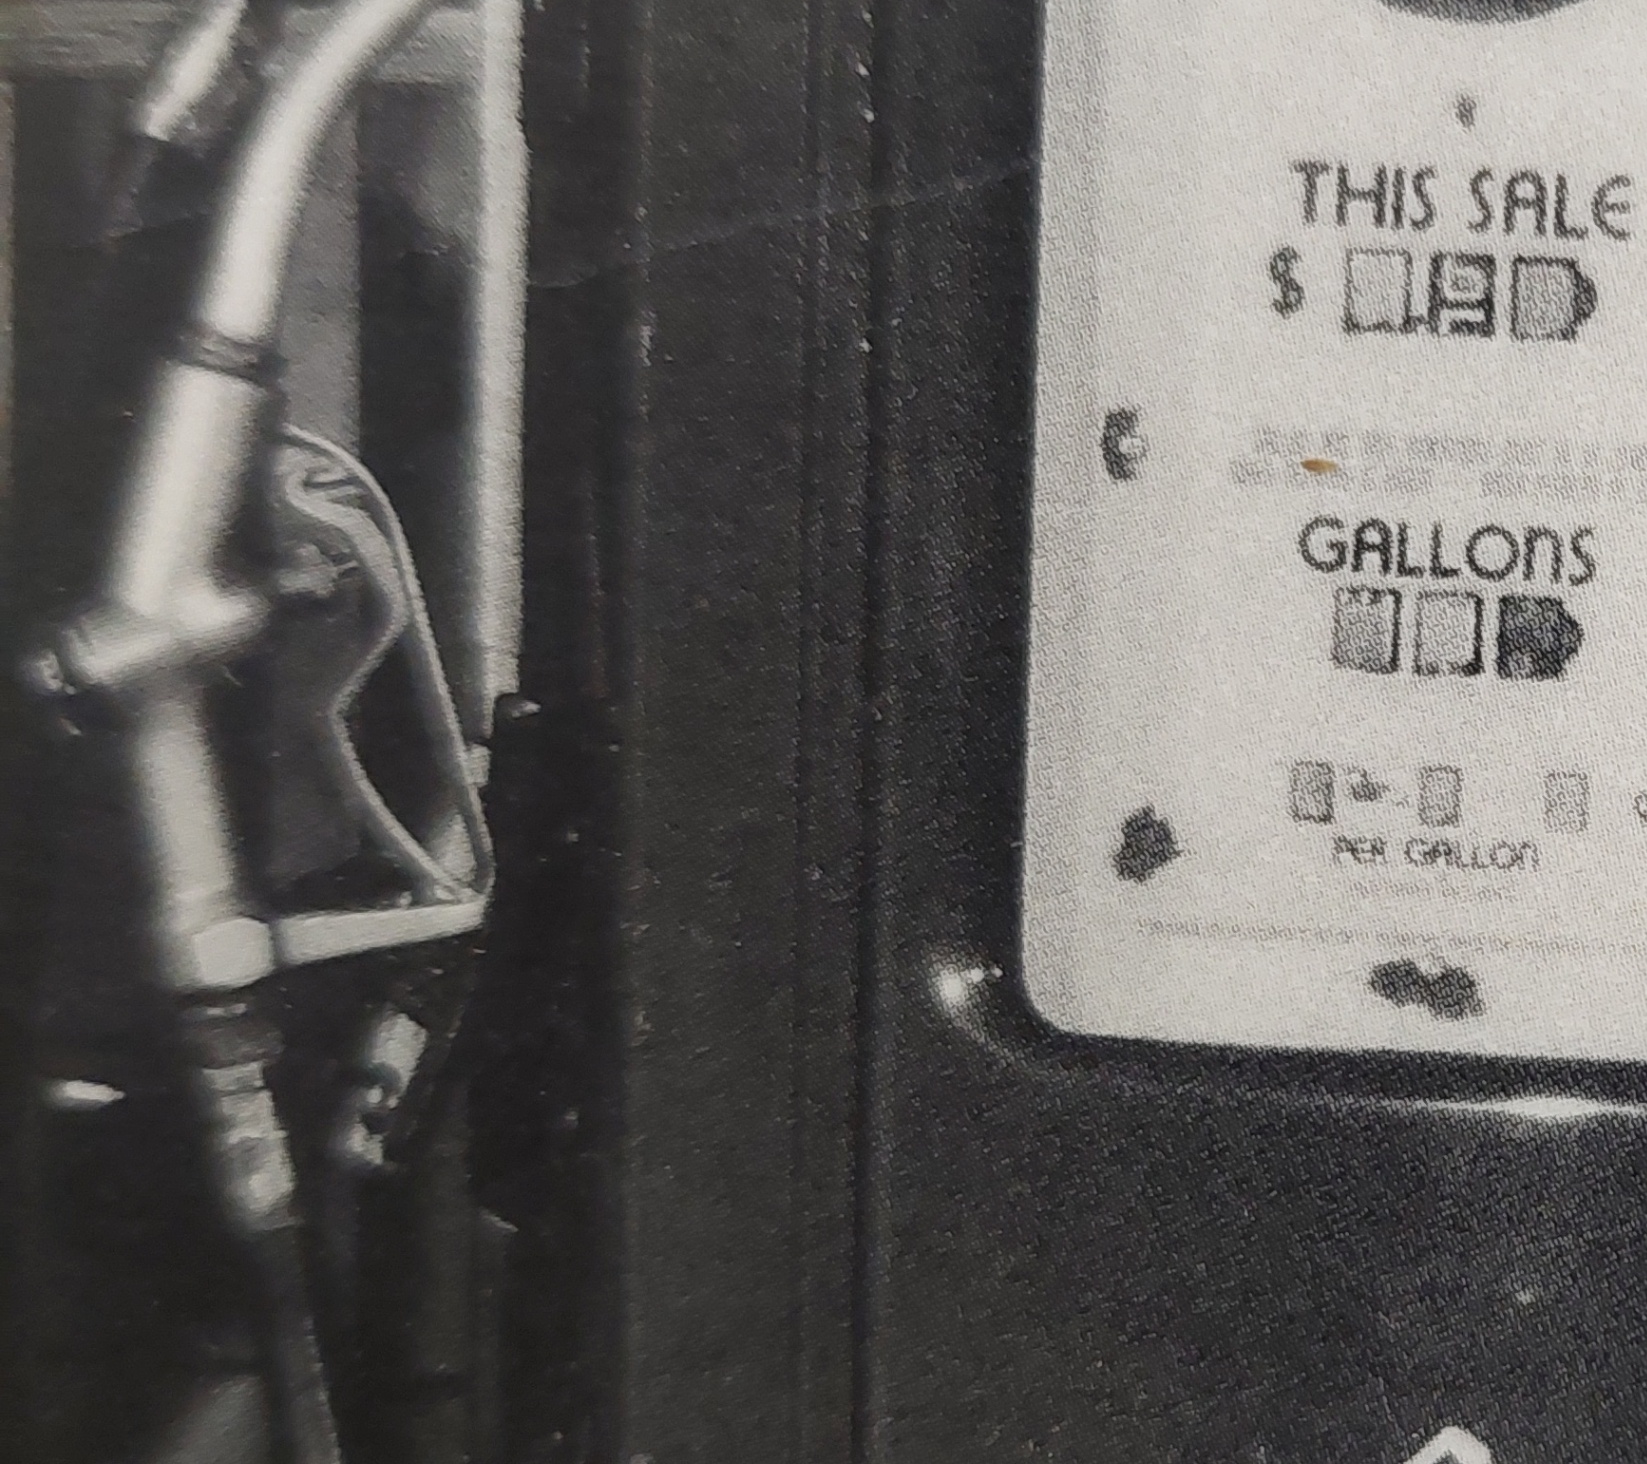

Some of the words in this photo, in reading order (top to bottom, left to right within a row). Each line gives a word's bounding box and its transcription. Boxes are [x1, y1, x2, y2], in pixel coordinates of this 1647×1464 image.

[1288, 158, 1436, 232] THIS
[1466, 168, 1635, 242] SALE
[1266, 245, 1304, 320] $
[1297, 515, 1598, 588] GALLONS
[1332, 835, 1388, 867] PER
[1404, 837, 1541, 871] GALLON
